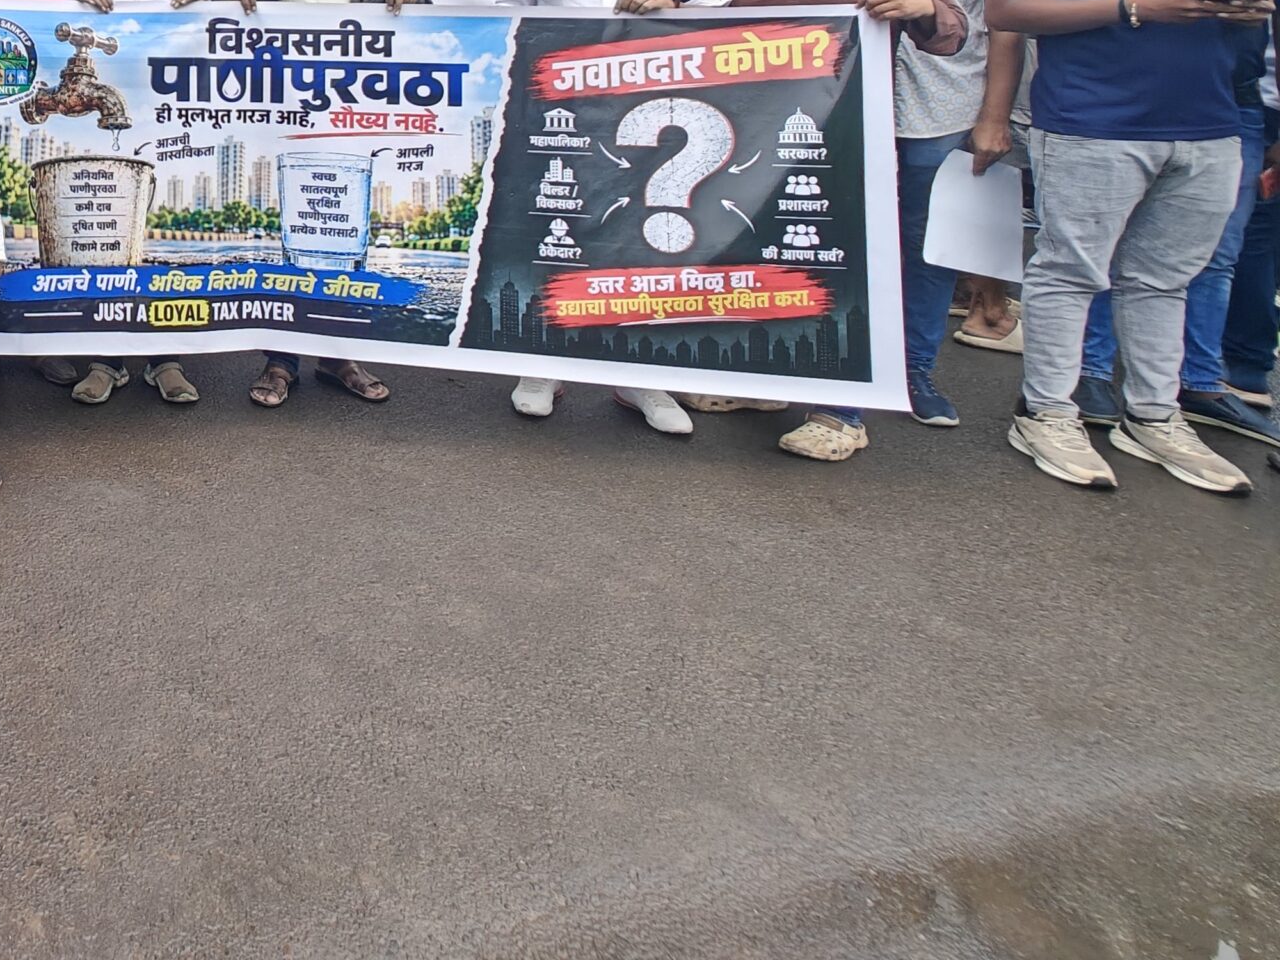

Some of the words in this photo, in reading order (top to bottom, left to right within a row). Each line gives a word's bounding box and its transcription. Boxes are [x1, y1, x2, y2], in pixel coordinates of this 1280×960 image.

[206, 17, 395, 57] विश्वसनीय
[552, 46, 706, 90] जवाबदार
[713, 30, 830, 76] कोण?
[147, 45, 470, 112] पाणीपुरवठा
[154, 103, 172, 124] ही
[176, 106, 231, 130] मूलभूत
[236, 107, 271, 125] गरज
[275, 105, 316, 129] आहे,
[329, 105, 388, 130] सौख्य
[155, 132, 190, 149] आजची
[529, 134, 591, 148] महापालिका?
[396, 144, 434, 159] आपली
[776, 148, 827, 160] सरकार?
[397, 160, 424, 172] गरज
[72, 169, 114, 181] अनियमित
[311, 172, 337, 182] स्वच्छ
[69, 182, 117, 196] पाणीपुरवठा
[74, 201, 94, 212] कमी
[306, 197, 341, 211] सुरक्षित
[535, 195, 583, 210] विकसक?
[777, 199, 829, 212] प्रशासन?
[297, 210, 349, 225] पाणीपुरवठा
[72, 219, 93, 234] दूषित
[96, 219, 117, 231] पाणी
[289, 224, 318, 235] प्रत्येक
[71, 241, 98, 252] रिकामे
[100, 241, 121, 252] टाकी
[538, 243, 582, 259] ठेकेदार?
[761, 245, 779, 260] की
[780, 248, 815, 261] आपण
[32, 268, 90, 293] आजचे
[96, 268, 142, 293] पाणी,
[148, 271, 203, 292] अधिक
[207, 269, 257, 291] निरोगी
[261, 271, 317, 294] उद्याचे
[322, 277, 384, 300] जीवन.
[586, 276, 625, 295] उत्तर
[630, 274, 674, 293] आज
[728, 270, 762, 288] द्या.
[556, 299, 605, 316] उद्याचा
[610, 293, 704, 319] पाणीपुरवठा
[707, 288, 769, 315] सुरक्षित
[774, 290, 815, 307] करा.
